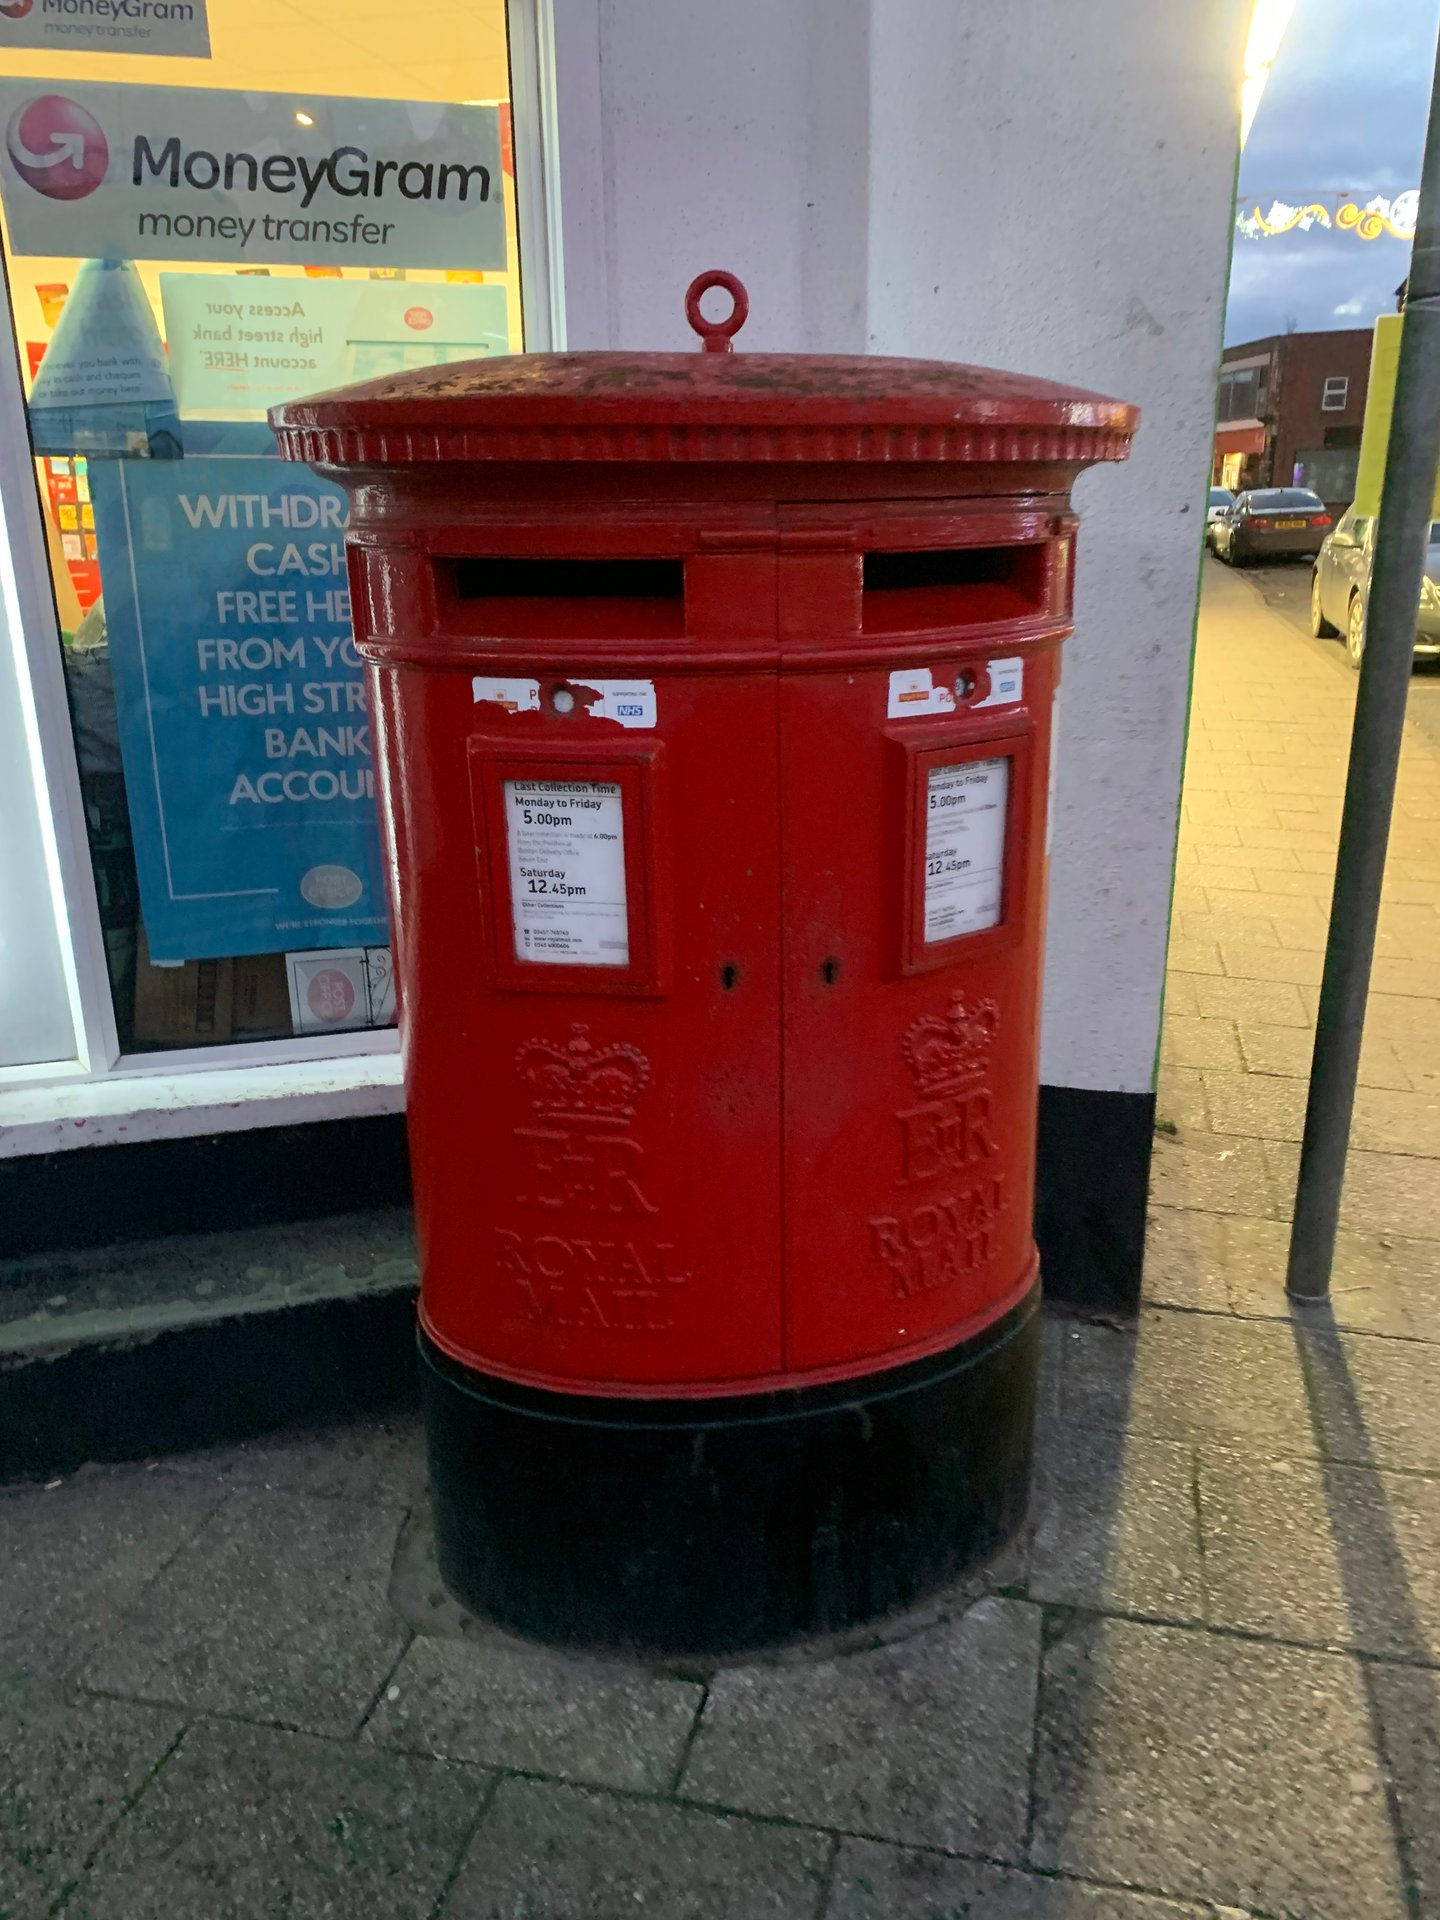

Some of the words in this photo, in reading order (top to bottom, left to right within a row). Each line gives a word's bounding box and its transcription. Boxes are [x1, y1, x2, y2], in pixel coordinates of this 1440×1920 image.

[42, 0, 194, 21] MoneyGram
[44, 23, 92, 36] money
[96, 25, 152, 38] transfer
[132, 135, 490, 207] MoneyGram
[138, 211, 256, 247] money
[263, 213, 396, 245] transfer
[246, 543, 347, 576] CASH
[217, 590, 298, 624] FREE
[197, 637, 306, 671] FROM
[199, 684, 293, 717] HIGH
[618, 706, 643, 715] NHS
[264, 726, 371, 759] BANK
[514, 782, 535, 791] Last
[538, 783, 588, 793] Collection
[590, 783, 616, 794] Time
[965, 775, 989, 785] Friday
[515, 796, 555, 809] Monday
[557, 799, 567, 808] to
[569, 798, 602, 811] Friday
[930, 794, 966, 809] 5.00pm
[523, 809, 572, 827] 5.00pm
[520, 867, 566, 880] Saturday
[928, 859, 971, 876] 12.45pm
[527, 879, 587, 897] 12.45pm
[494, 1226, 692, 1283] ROYAL
[515, 1278, 675, 1330] MAIL
